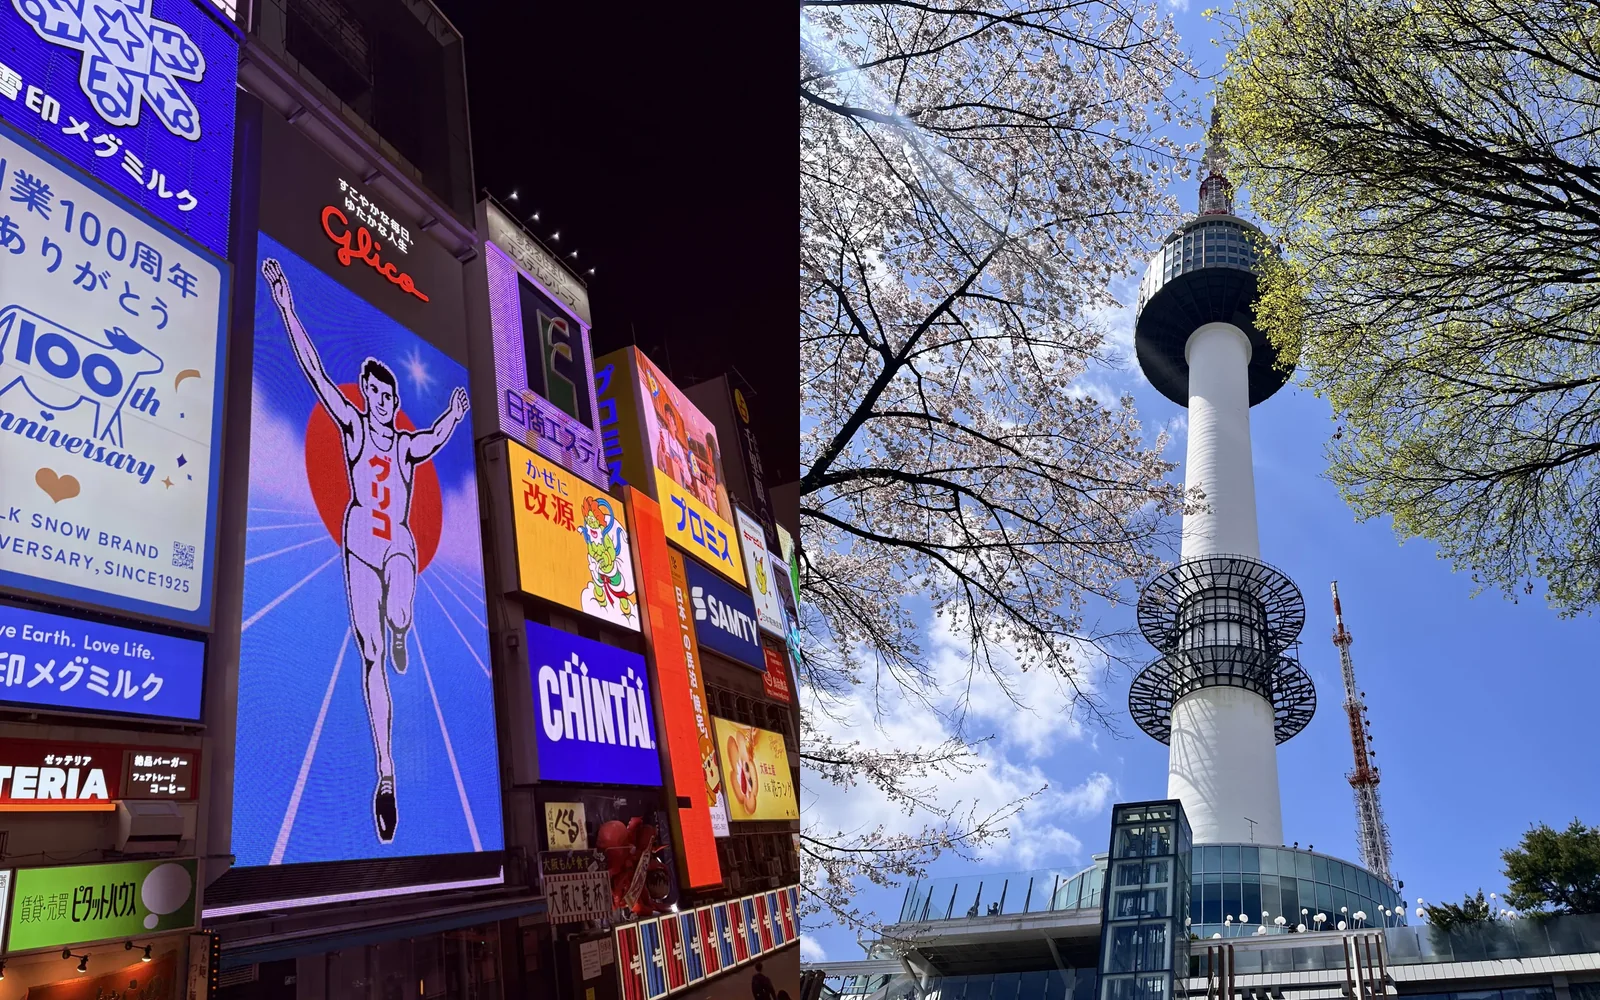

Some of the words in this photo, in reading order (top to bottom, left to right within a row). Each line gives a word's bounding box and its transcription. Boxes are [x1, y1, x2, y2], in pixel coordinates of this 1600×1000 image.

[0, 61, 198, 212] 雪印メグミルク
[0, 158, 199, 300] 業100周年
[344, 196, 408, 254] ゆたかな人生
[0, 214, 169, 331] ありがとう
[321, 205, 430, 302] Glico
[594, 363, 629, 487] プロミス
[368, 454, 393, 542] グリコ
[525, 459, 569, 497] かぜに
[522, 479, 577, 533] 改源
[670, 493, 735, 568] プロミス
[30, 513, 91, 541] SNOW
[98, 532, 159, 559] BRAND
[22, 624, 76, 648] Earth.
[83, 634, 120, 655] Love
[123, 641, 156, 661] Life.
[707, 594, 759, 647] SAMTY
[0, 651, 164, 702] 印メグミルク
[44, 754, 92, 766] ゼッテリア
[132, 773, 177, 782] フェアトレード
[150, 784, 186, 794] コーヒー
[71, 882, 136, 923] ピタットハウス
